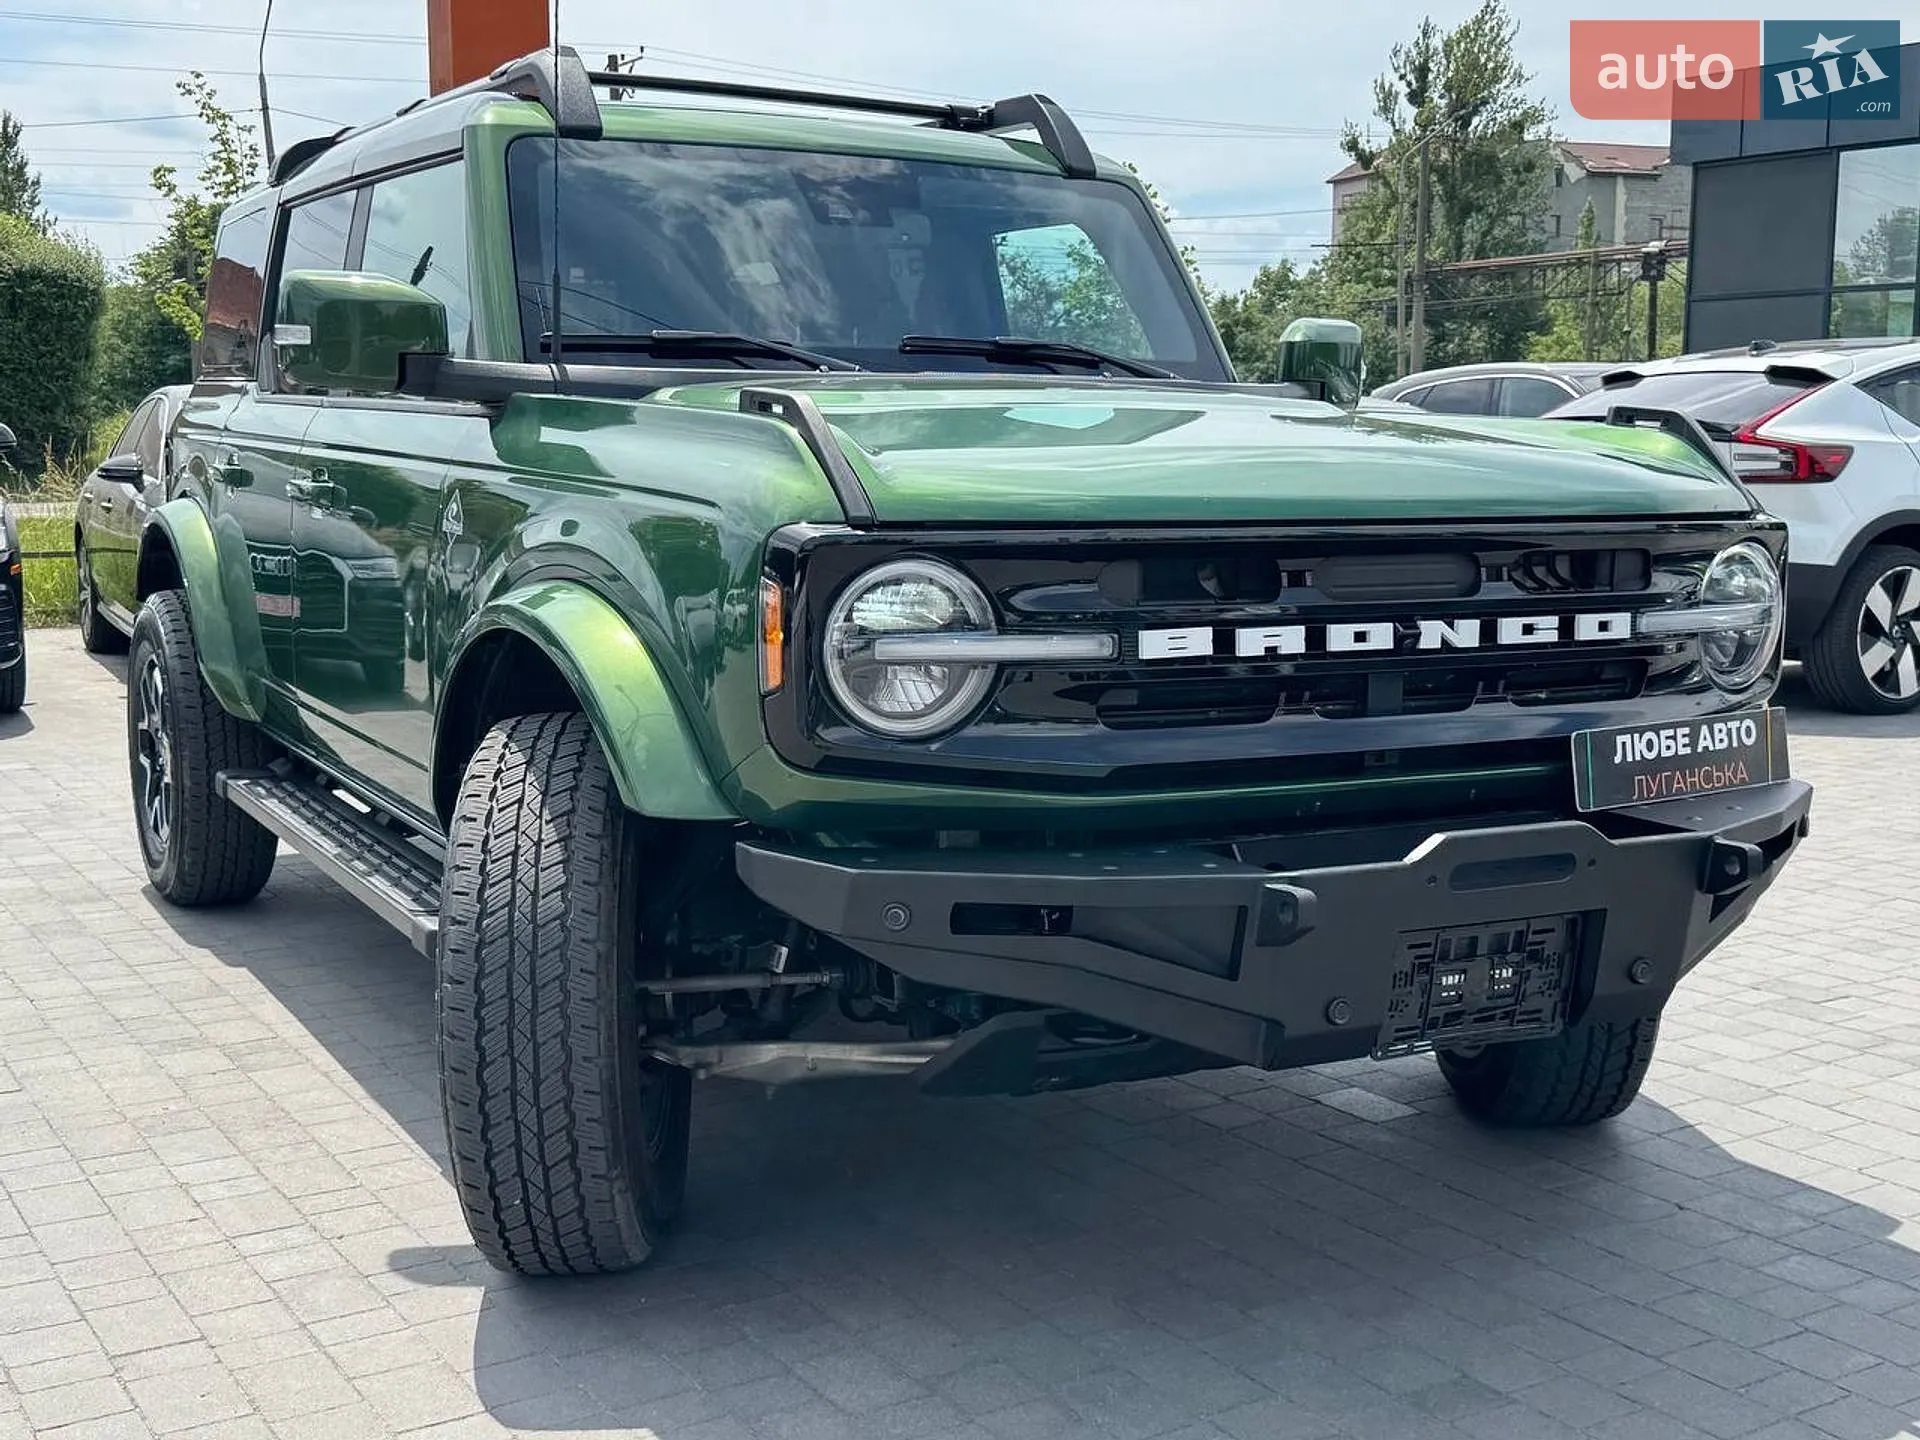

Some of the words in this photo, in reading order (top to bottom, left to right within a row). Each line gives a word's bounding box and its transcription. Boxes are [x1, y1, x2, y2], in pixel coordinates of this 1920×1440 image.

[1138, 612, 1632, 660] BRONCO
[1613, 726, 1691, 764] ЛЮБЕ
[1697, 718, 1757, 753] АВТО
[1632, 760, 1749, 800] ЛУГАНСЬКА
